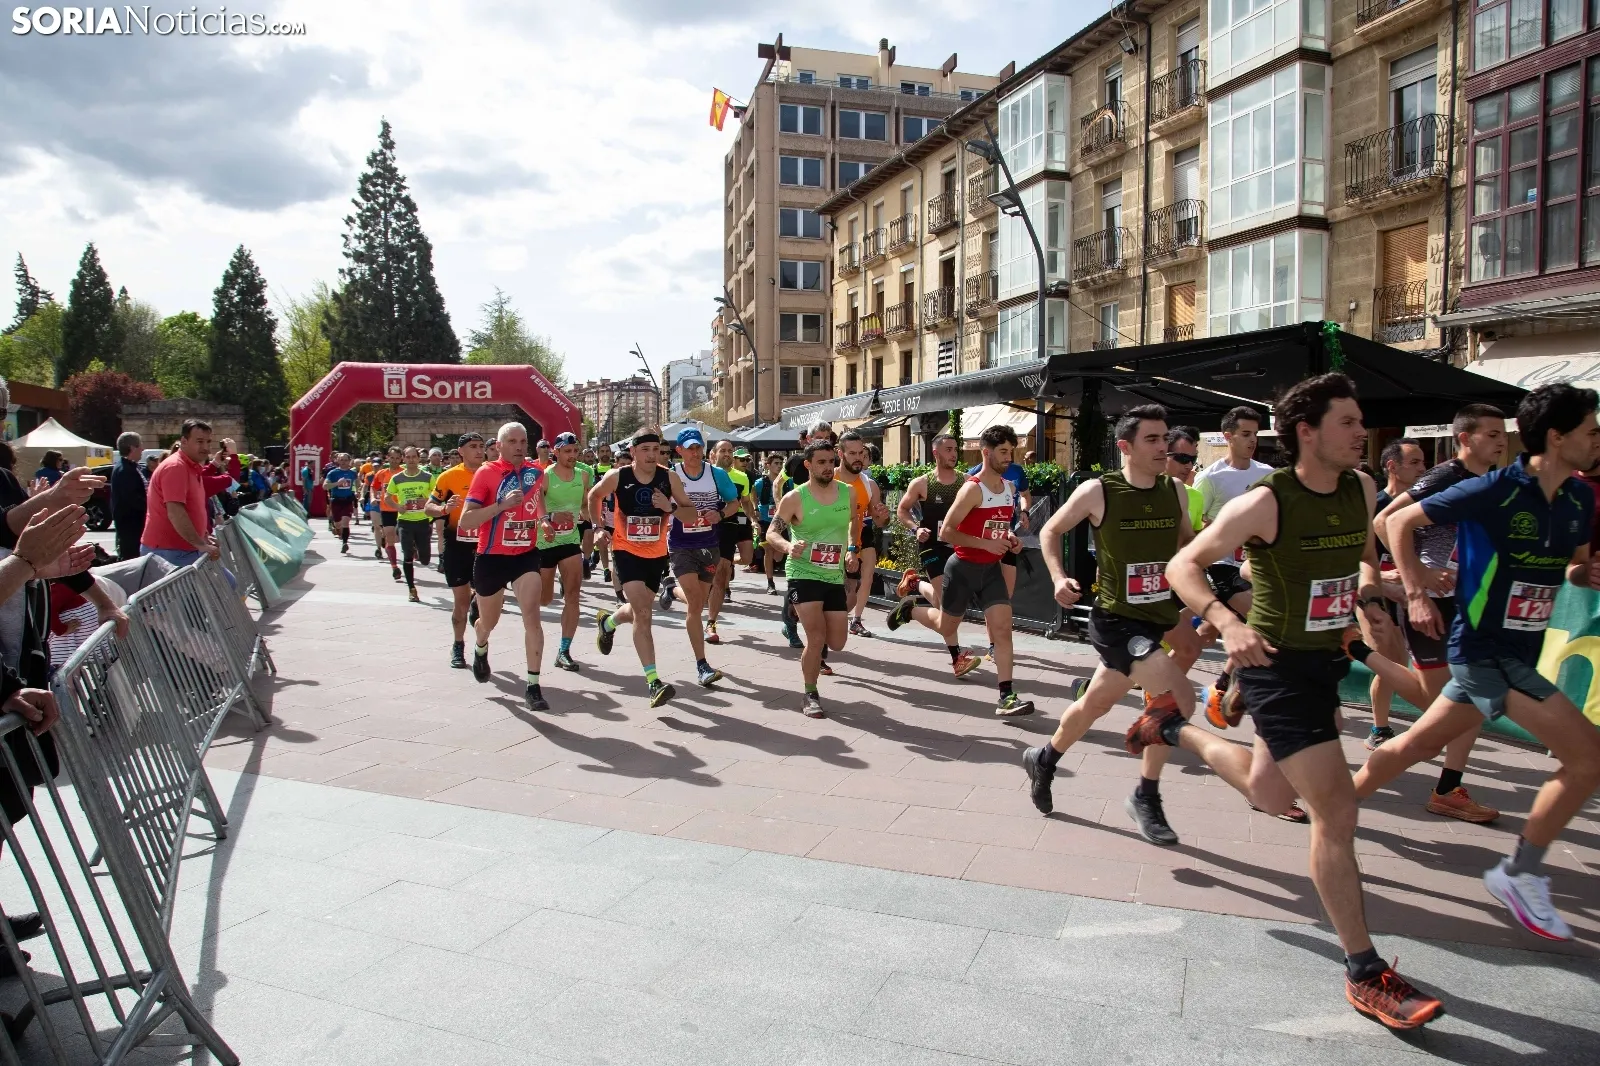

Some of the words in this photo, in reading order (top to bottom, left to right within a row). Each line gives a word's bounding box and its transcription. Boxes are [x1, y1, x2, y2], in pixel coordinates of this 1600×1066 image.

[411, 374, 492, 399] Soria
[1018, 373, 1044, 389] YORK
[530, 374, 570, 413] #EligeSoria
[881, 398, 901, 414] DESDE
[903, 395, 921, 411] 1957
[636, 525, 652, 535] 20
[1134, 518, 1176, 529] RUNNERS
[465, 528, 478, 537] 11
[513, 529, 529, 540] 74
[991, 529, 1006, 540] 67
[820, 551, 837, 563] 73
[1141, 575, 1161, 593] 58
[1326, 593, 1353, 615] 43
[1517, 600, 1553, 619] 120
